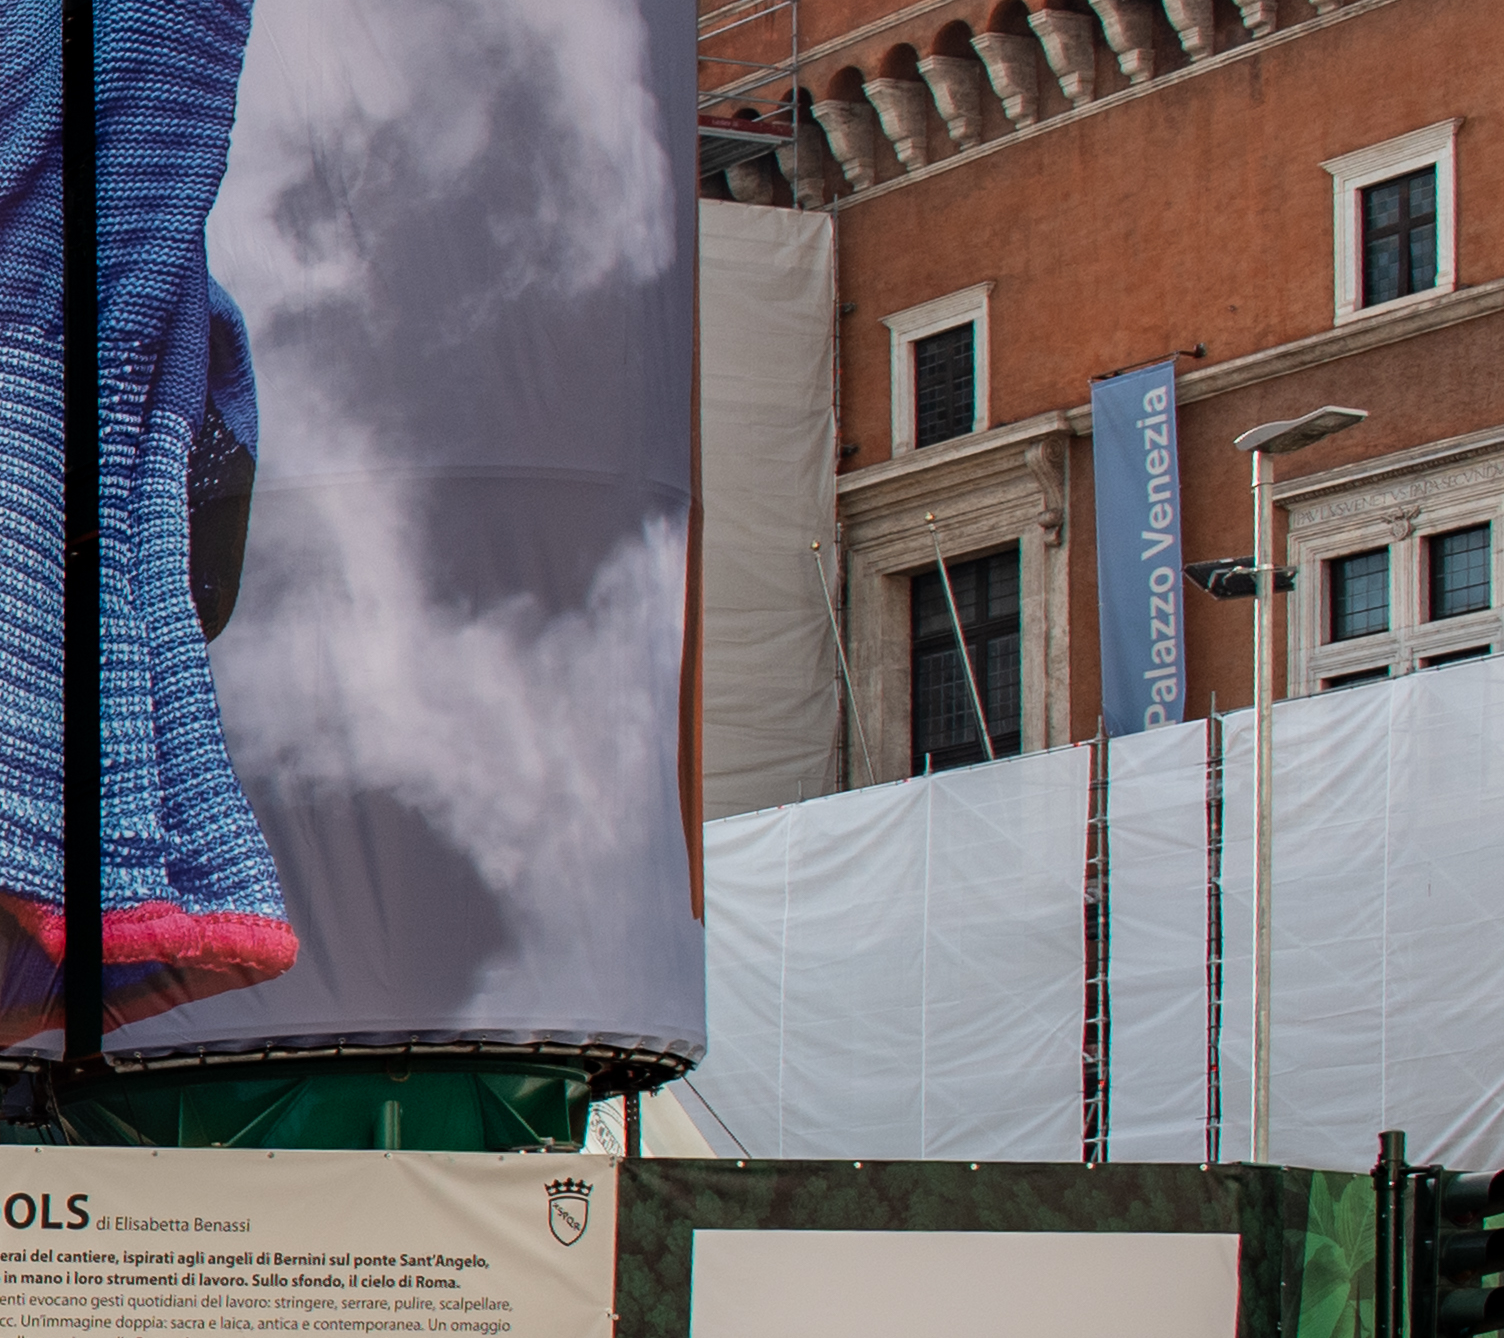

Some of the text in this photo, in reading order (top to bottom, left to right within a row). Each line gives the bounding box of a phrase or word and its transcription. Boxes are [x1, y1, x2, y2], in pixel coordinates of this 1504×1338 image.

[1136, 384, 1178, 732] Palazzo Venezia
[96, 1215, 110, 1231] di
[115, 1215, 189, 1232] Elisabetta
[194, 1217, 250, 1233] Benassi
[30, 1248, 53, 1262] del
[56, 1249, 119, 1265] cantiere,
[123, 1250, 174, 1267] ispirati
[177, 1250, 204, 1268] agli
[207, 1251, 253, 1268] angeli
[256, 1251, 270, 1265] di
[273, 1252, 326, 1266] Bernini
[329, 1252, 350, 1266] sul
[353, 1254, 396, 1270] ponte
[399, 1253, 489, 1271] Sant'Angelo,
[4, 1270, 17, 1284] in
[20, 1274, 63, 1284] mano
[66, 1271, 70, 1284] i
[74, 1271, 103, 1285] loro
[106, 1271, 178, 1286] strumenti
[181, 1272, 195, 1286] di
[199, 1272, 248, 1287] lavoro.
[251, 1273, 288, 1287] Sullo
[291, 1273, 345, 1289] sfondo,
[348, 1274, 357, 1288] il
[360, 1274, 395, 1288] cielo
[398, 1274, 412, 1288] di
[415, 1275, 460, 1289] Roma.
